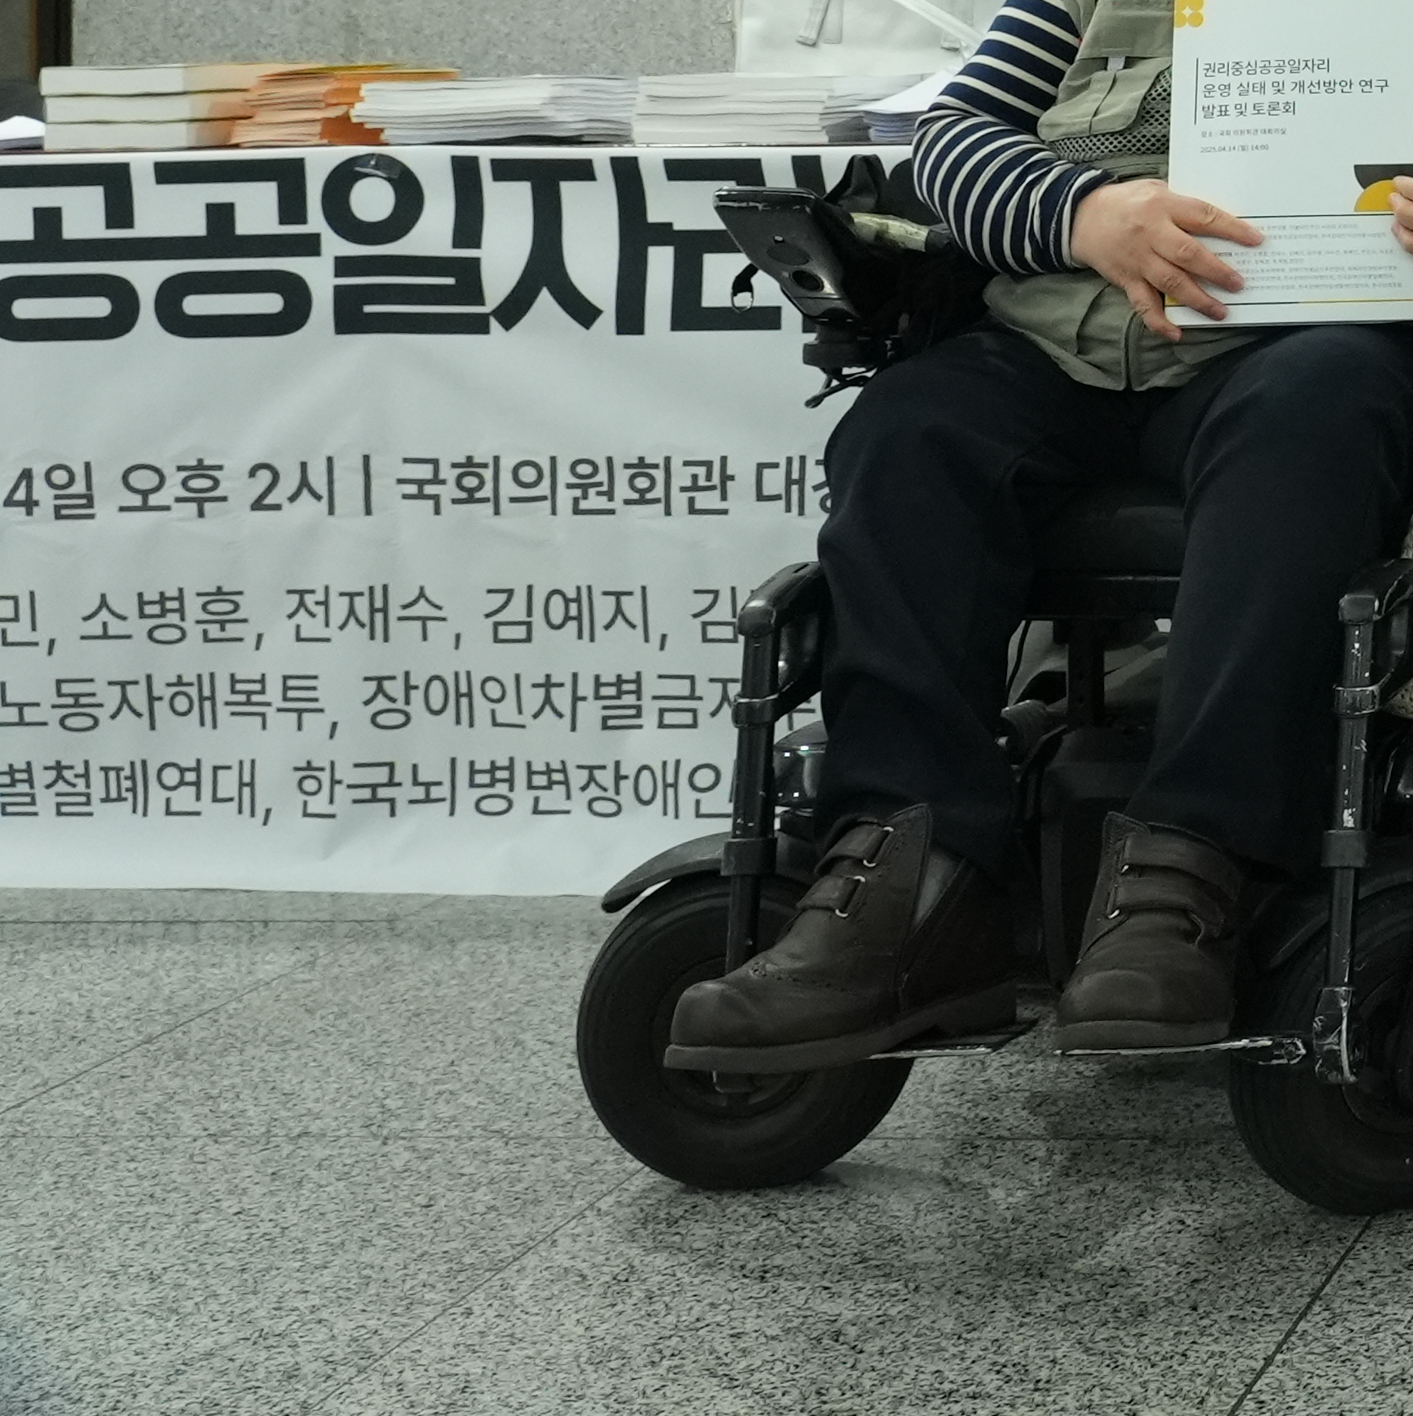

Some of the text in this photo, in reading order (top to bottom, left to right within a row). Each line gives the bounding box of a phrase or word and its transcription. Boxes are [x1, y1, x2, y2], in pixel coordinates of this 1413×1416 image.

[1203, 58, 1331, 78] 권리중심공공일자리
[1203, 78, 1389, 98] 운영 실태 및 개선방안 연구
[1202, 101, 1296, 119] 발표 및 토론회
[2, 460, 97, 521] 4일
[118, 458, 228, 518] 오후
[248, 455, 335, 516] 2시
[397, 453, 735, 519] 국회의원회관
[80, 585, 264, 651] 소병훈,
[285, 584, 464, 650] 전재수,
[483, 584, 668, 651] 김예지,
